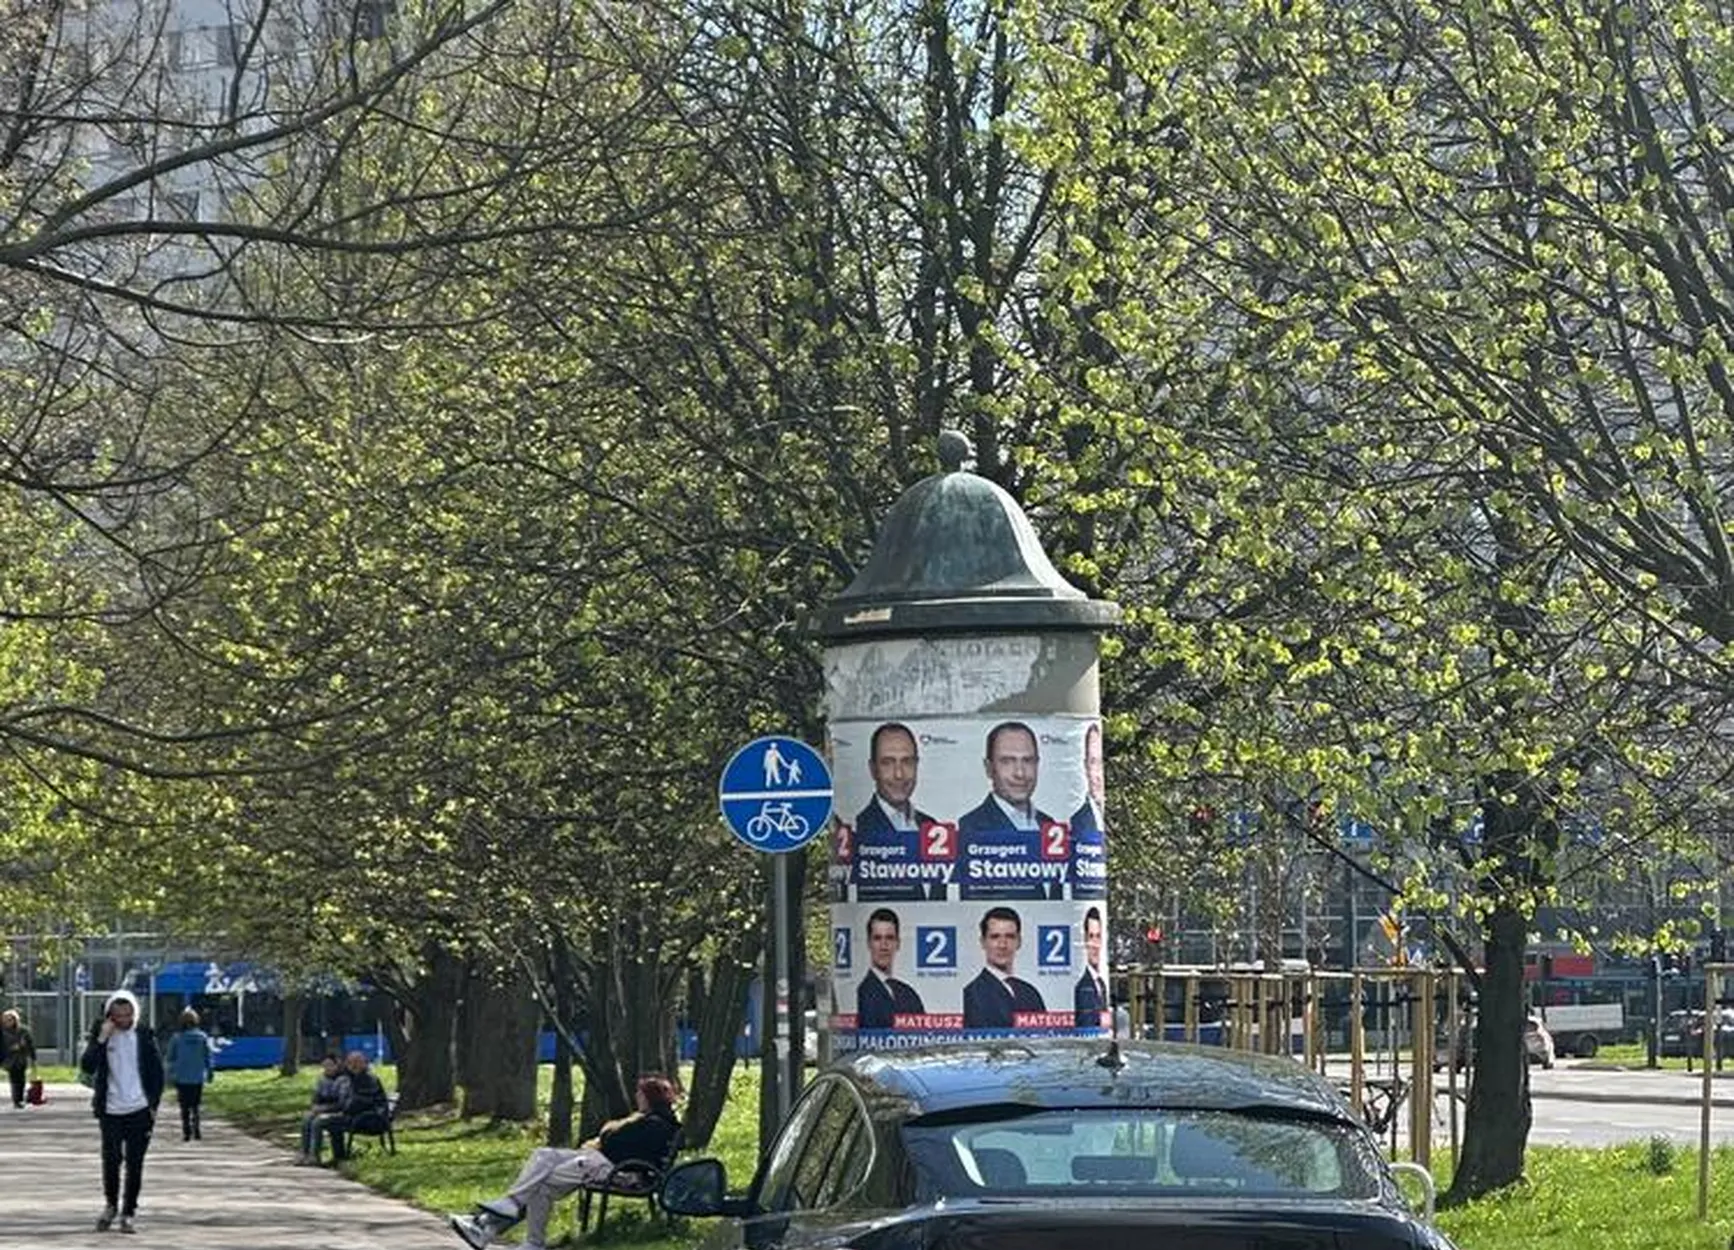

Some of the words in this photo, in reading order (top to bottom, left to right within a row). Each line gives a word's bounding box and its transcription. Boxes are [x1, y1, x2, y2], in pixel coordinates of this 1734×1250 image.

[928, 826, 949, 855] 2
[968, 844, 1027, 858] Grzegorz
[1047, 825, 1065, 855] 2
[860, 860, 955, 884] Stawowy
[968, 859, 1069, 883] Stawowy
[925, 931, 949, 964] 2
[1046, 930, 1063, 963] 2
[893, 1015, 964, 1029] MATEUSZ
